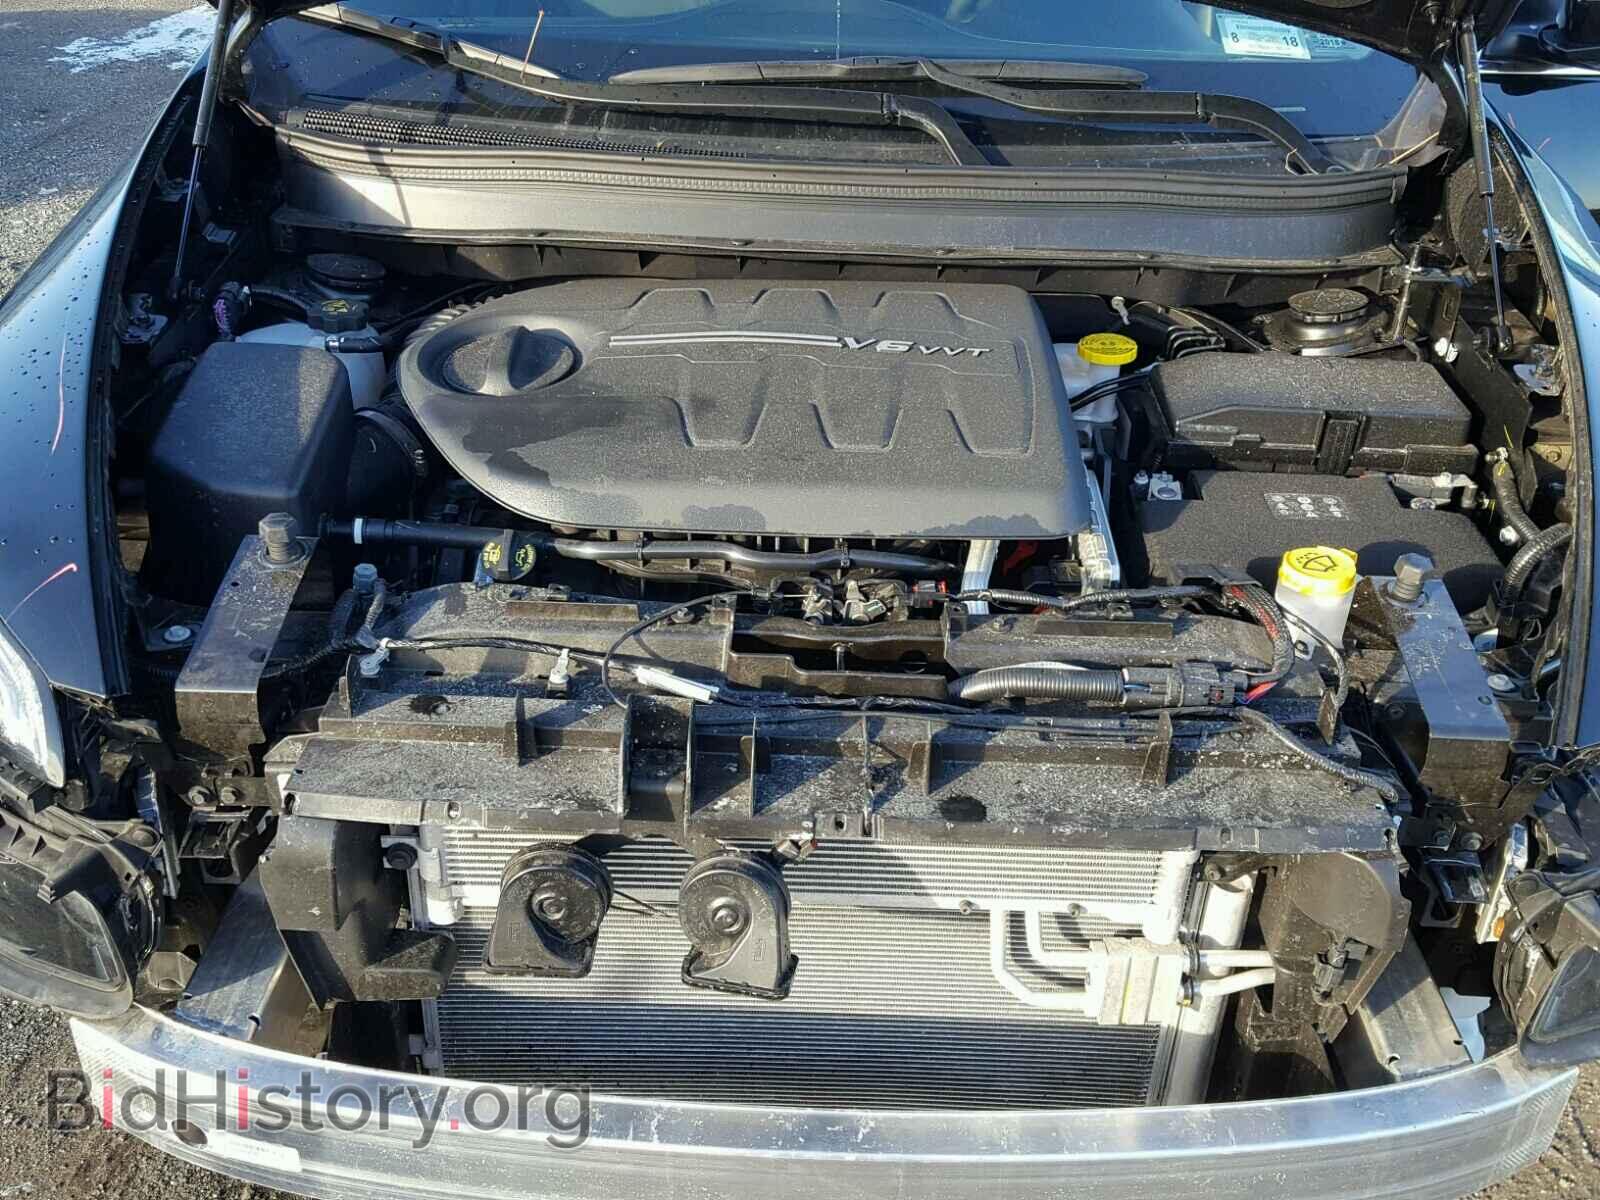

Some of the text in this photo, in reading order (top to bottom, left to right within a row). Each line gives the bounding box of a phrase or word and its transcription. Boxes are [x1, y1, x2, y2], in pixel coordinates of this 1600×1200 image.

[1230, 31, 1240, 44] 8
[1282, 35, 1299, 48] 18
[843, 336, 993, 357] V6 VVT
